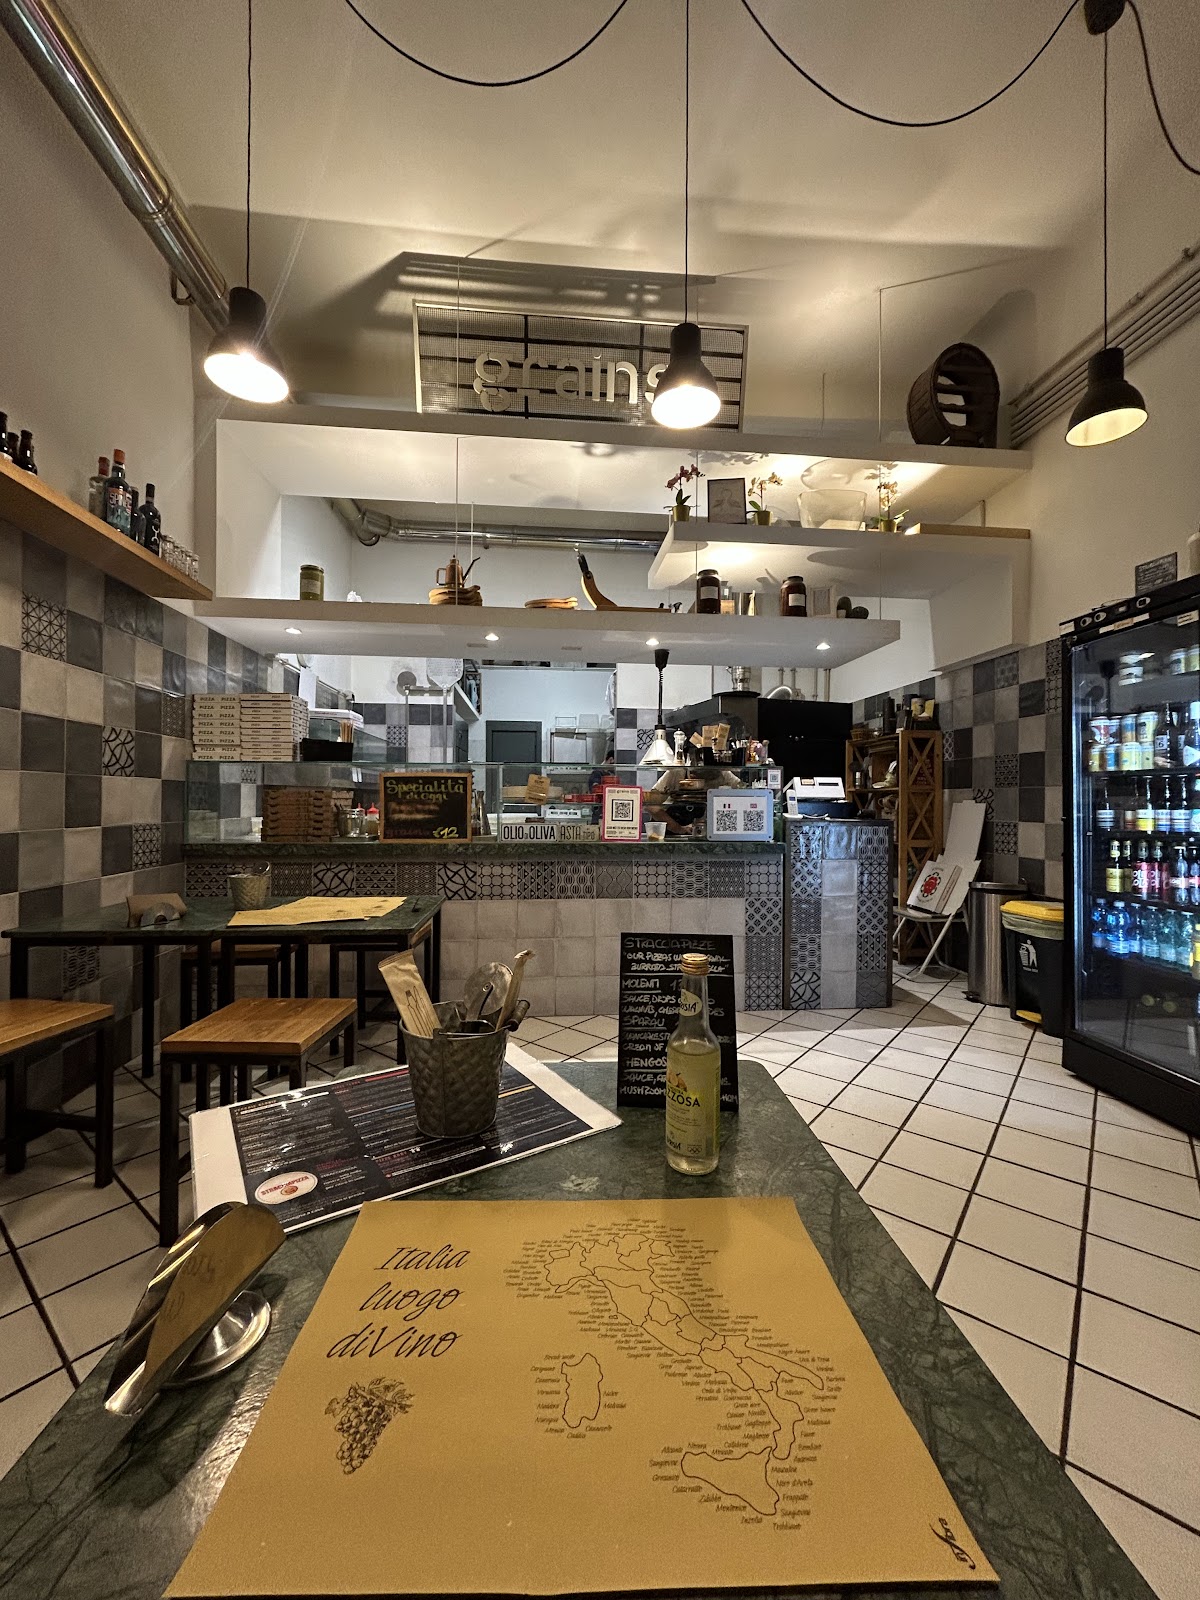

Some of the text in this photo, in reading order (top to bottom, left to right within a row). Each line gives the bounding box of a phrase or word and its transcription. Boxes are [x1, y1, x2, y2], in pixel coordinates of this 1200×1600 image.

[386, 779, 465, 798] Specialità
[503, 826, 524, 840] OLIO
[529, 826, 556, 840] OLIVA
[558, 826, 581, 840] ASTA
[374, 1244, 471, 1271] Italia
[358, 1281, 466, 1322] luogo
[326, 1322, 464, 1358] diVino
